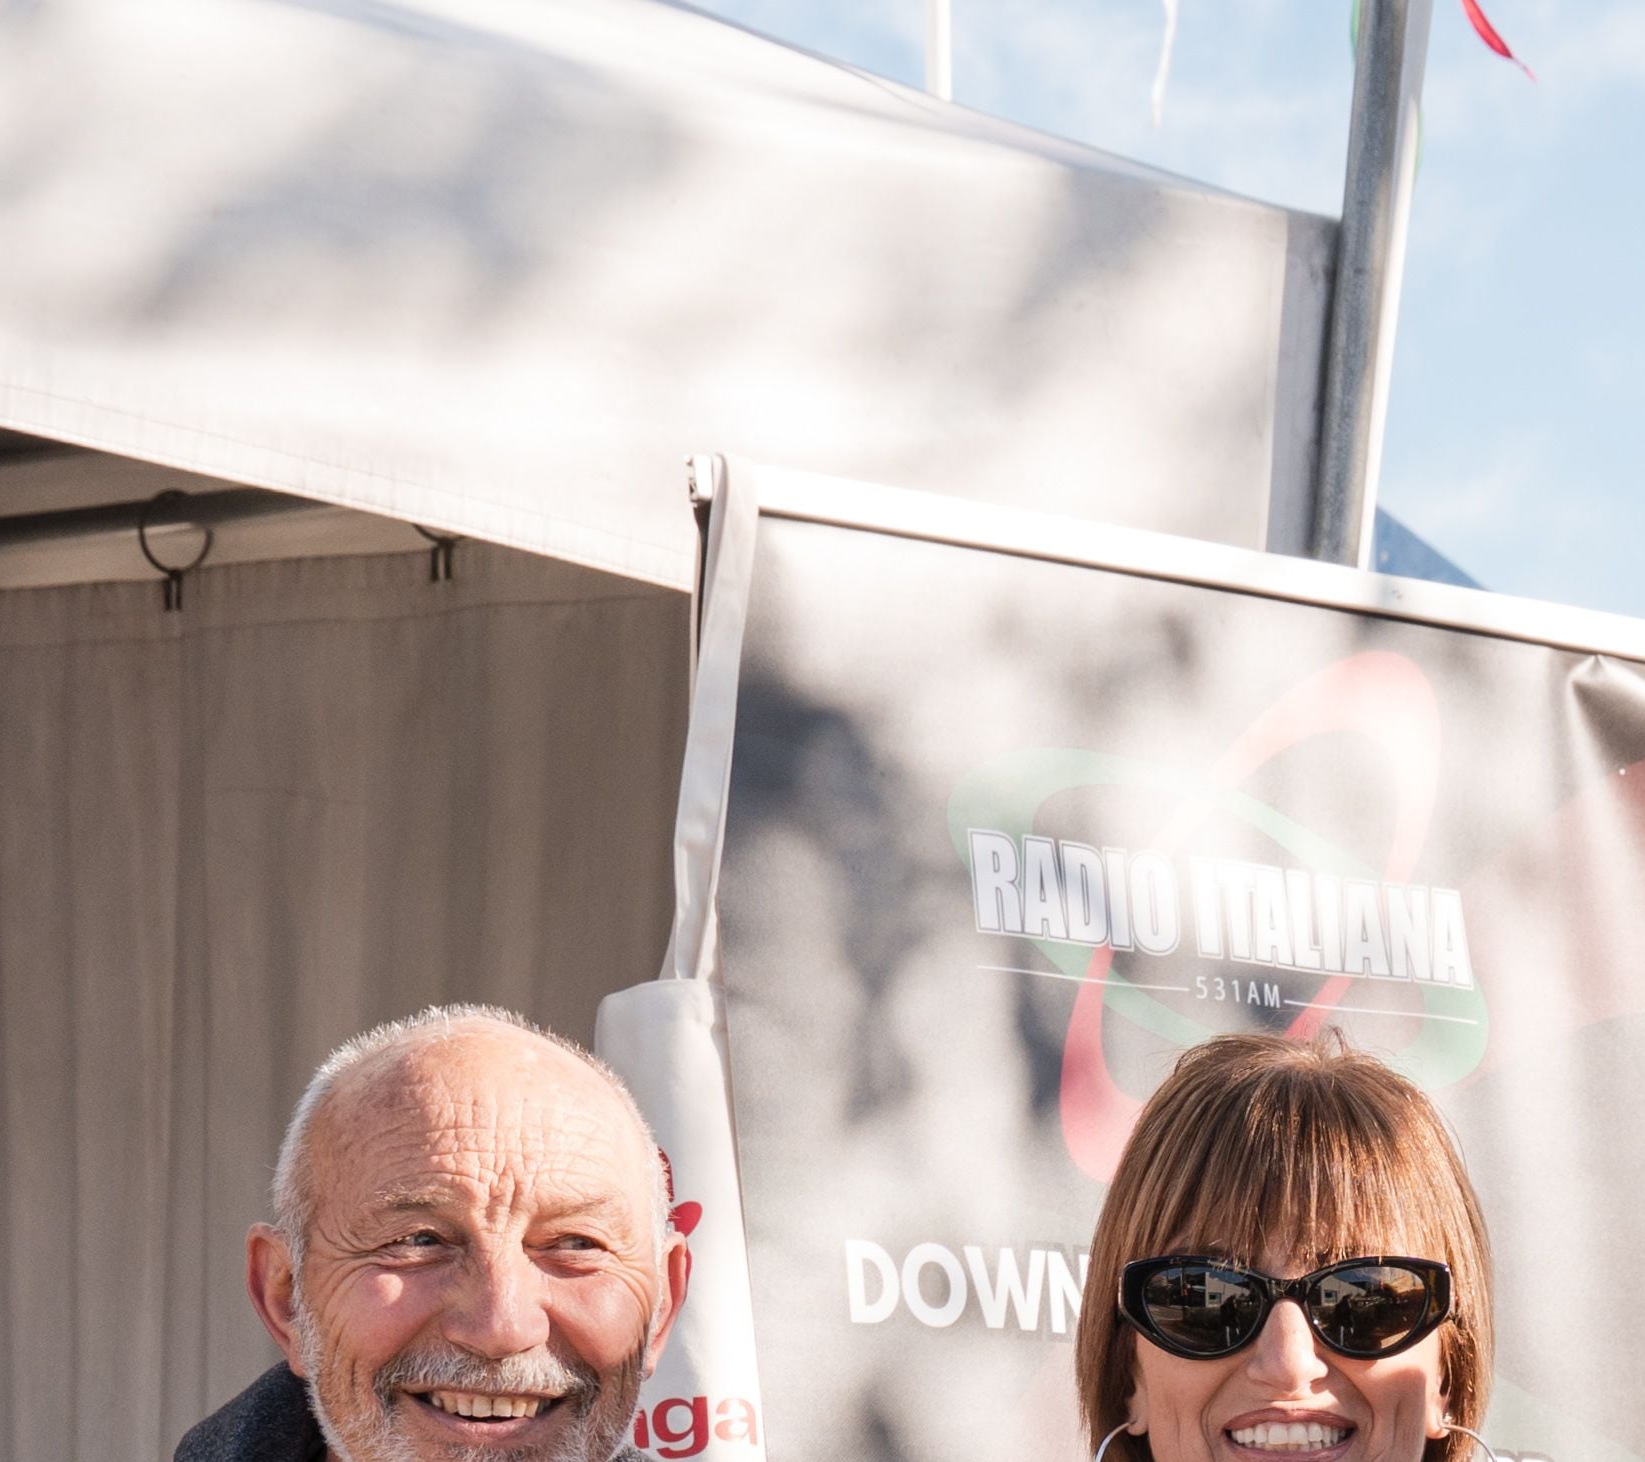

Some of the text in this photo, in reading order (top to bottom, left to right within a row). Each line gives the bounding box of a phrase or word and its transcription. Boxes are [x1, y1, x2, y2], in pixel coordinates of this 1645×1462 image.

[967, 827, 1475, 990] RADIO ITALIANA
[1195, 976, 1282, 1009] 531AM
